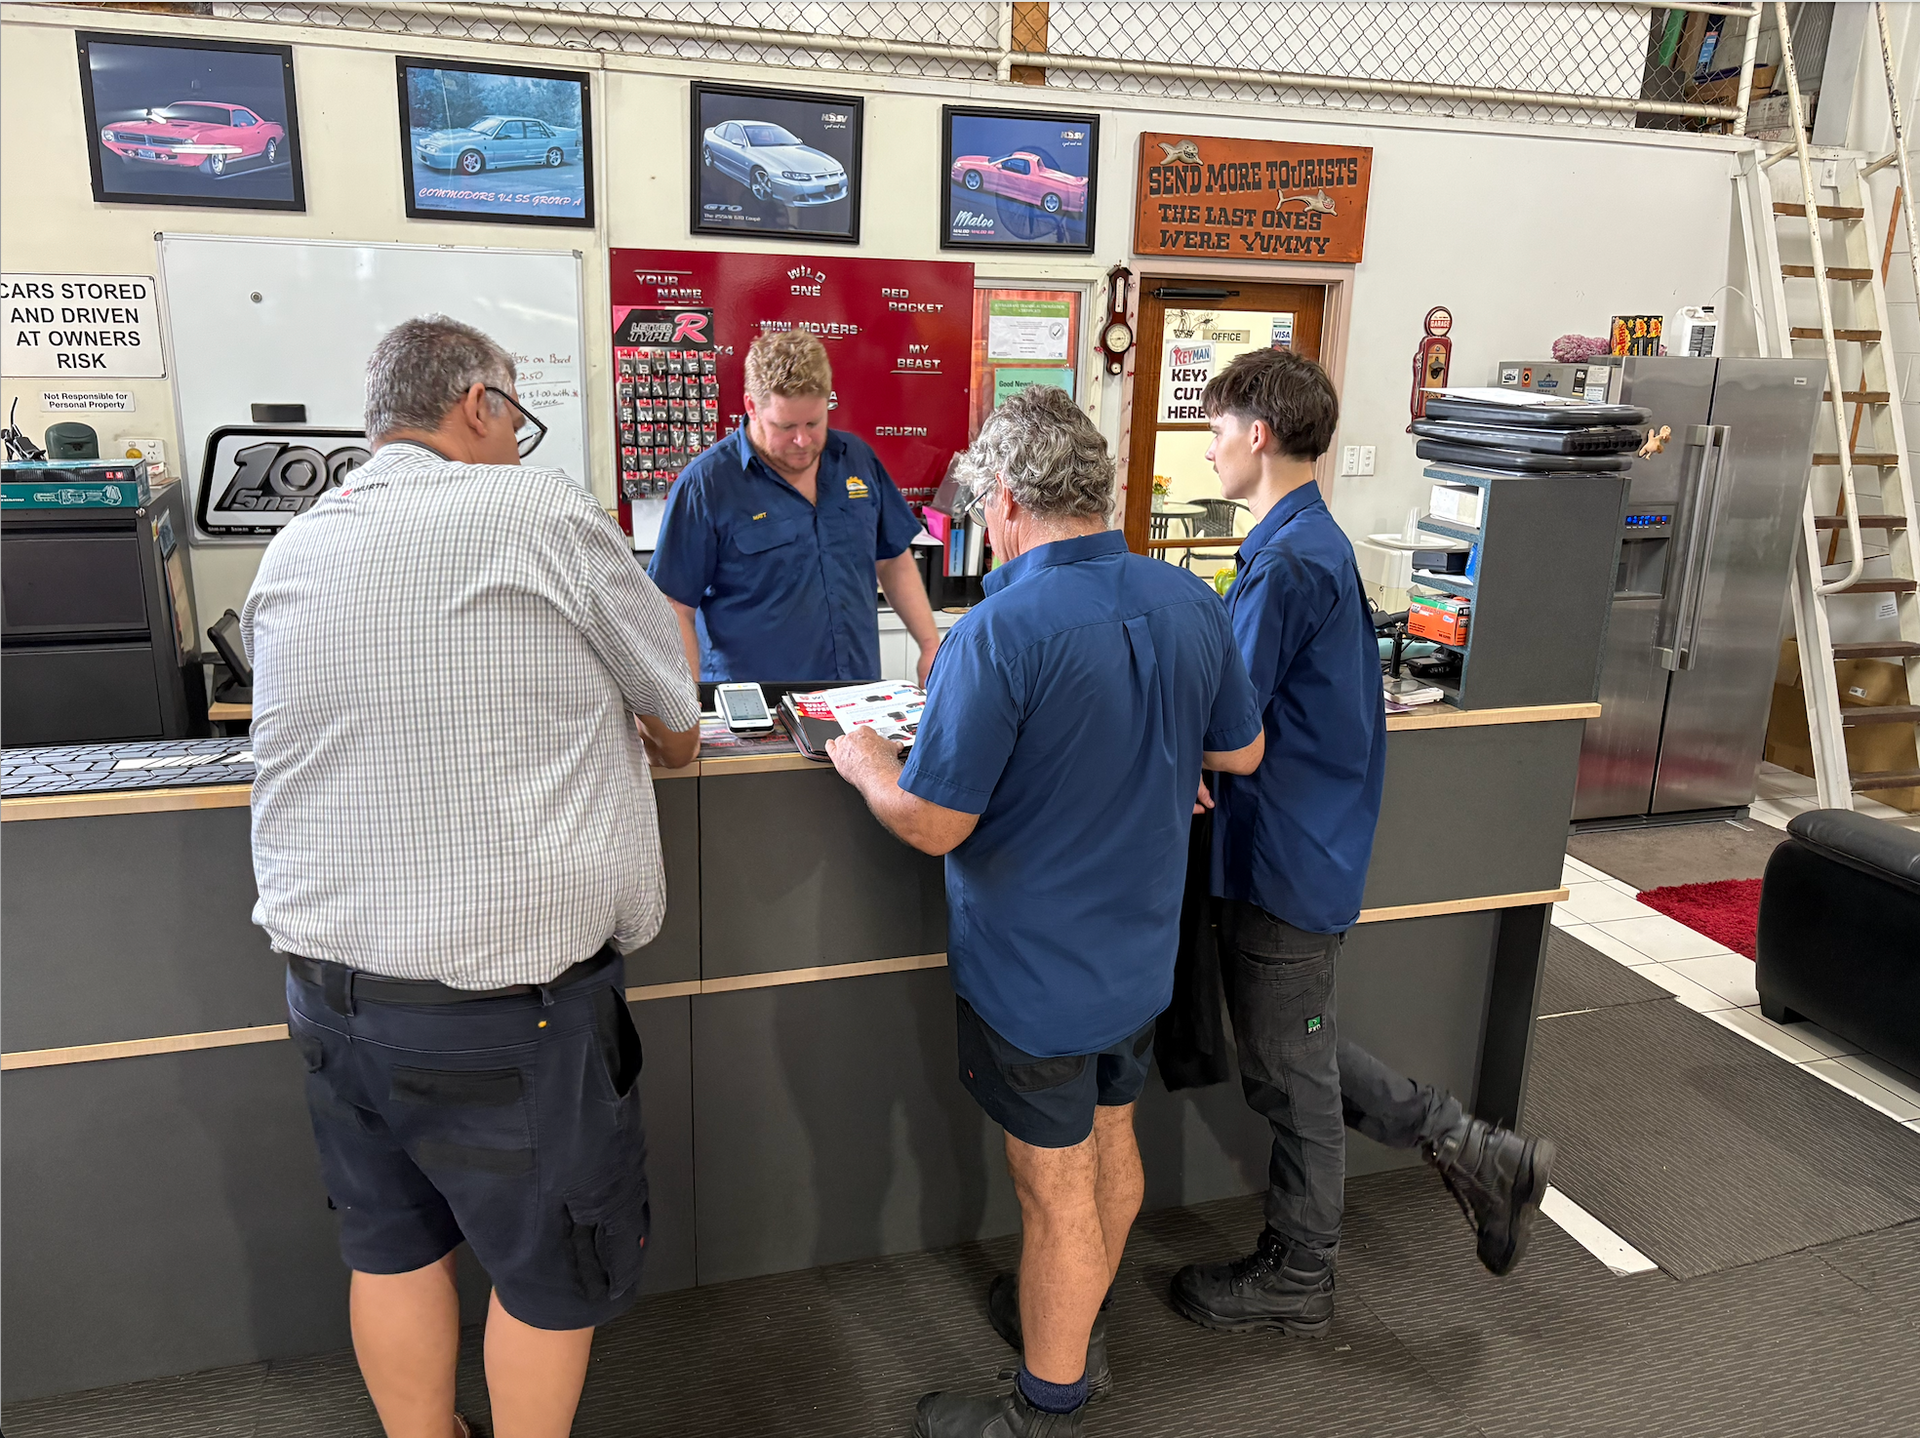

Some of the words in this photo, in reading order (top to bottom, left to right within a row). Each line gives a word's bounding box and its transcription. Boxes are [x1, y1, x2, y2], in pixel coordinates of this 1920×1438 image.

[1149, 165, 1201, 197] SEND
[1205, 161, 1262, 195] MORE
[1265, 157, 1358, 190] TOURISTS
[418, 187, 496, 202] COMMODORE
[514, 194, 530, 203] SS
[532, 195, 572, 207] GROUP
[572, 198, 581, 207] A
[703, 203, 743, 212] GTO
[953, 210, 994, 228] Maloo
[1158, 204, 1200, 225] THE
[1204, 206, 1257, 228] LAST
[1261, 210, 1322, 231] ONES
[1159, 230, 1230, 251] WERE
[1240, 231, 1331, 256] YUMMY
[636, 274, 679, 286] YOUR
[787, 264, 827, 283] WILD
[0, 282, 55, 299] CARS
[61, 283, 146, 299] STORED
[657, 288, 702, 299] NAME
[790, 284, 821, 297] ONE
[881, 287, 909, 299] RED
[888, 301, 944, 313] ROCKET
[11, 307, 55, 323] AND
[61, 308, 139, 323] DRIVEN
[629, 331, 672, 343] TYPE
[671, 312, 708, 343] R
[630, 322, 673, 333] LETTER
[760, 320, 792, 332] MINI
[798, 321, 858, 335] MOVERS
[1430, 320, 1451, 328] GARAGE
[16, 331, 41, 346] AT
[48, 331, 141, 346] OWNERS
[1211, 332, 1241, 342] OFFICE
[1273, 330, 1291, 339] VISA
[909, 344, 929, 354] MY
[57, 353, 107, 369] RISK
[1174, 347, 1210, 366] KEYMAN
[897, 358, 941, 369] BEAST
[1171, 369, 1208, 382] KEYS
[62, 393, 114, 402] Responsible
[1173, 387, 1203, 401] CUT
[49, 401, 87, 409] Personal
[89, 401, 125, 410] Property
[1167, 406, 1206, 419] HERE
[875, 426, 928, 437] CRUZIN
